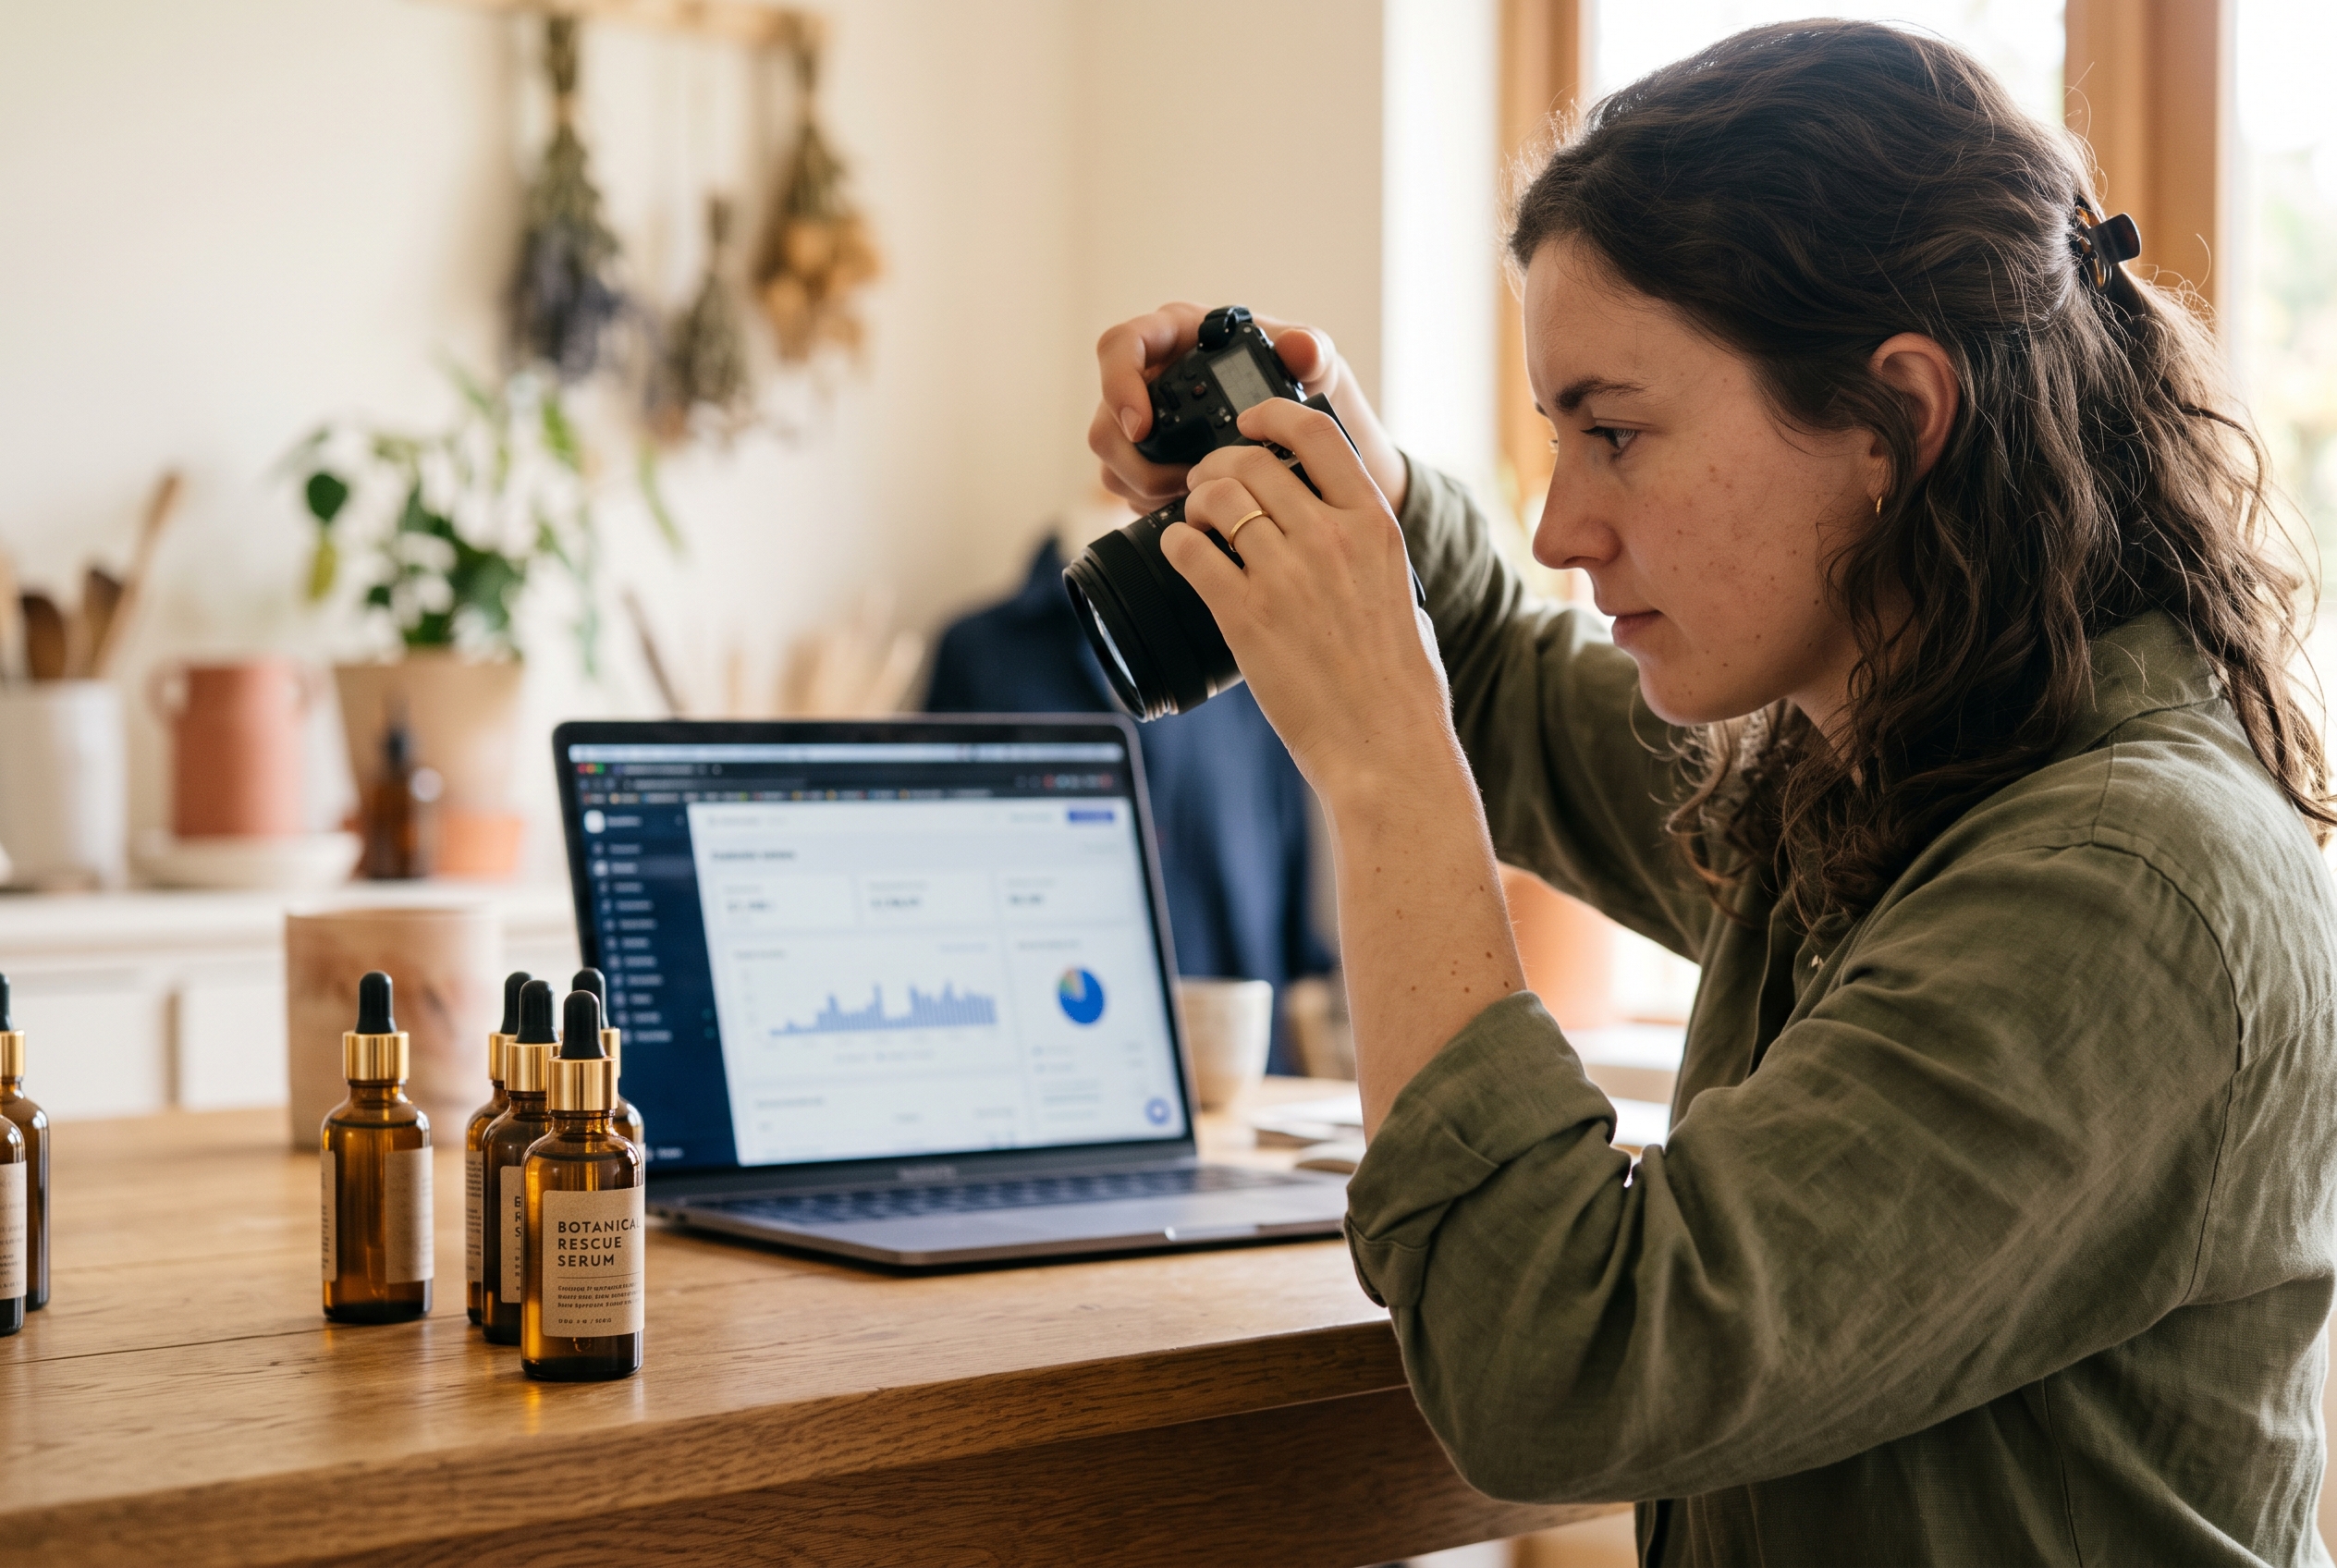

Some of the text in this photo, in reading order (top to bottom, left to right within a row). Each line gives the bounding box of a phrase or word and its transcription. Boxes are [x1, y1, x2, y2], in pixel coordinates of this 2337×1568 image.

[557, 1218, 641, 1233] BOTANICAL
[557, 1236, 622, 1250] RESCUE
[557, 1254, 615, 1268] SERUM
